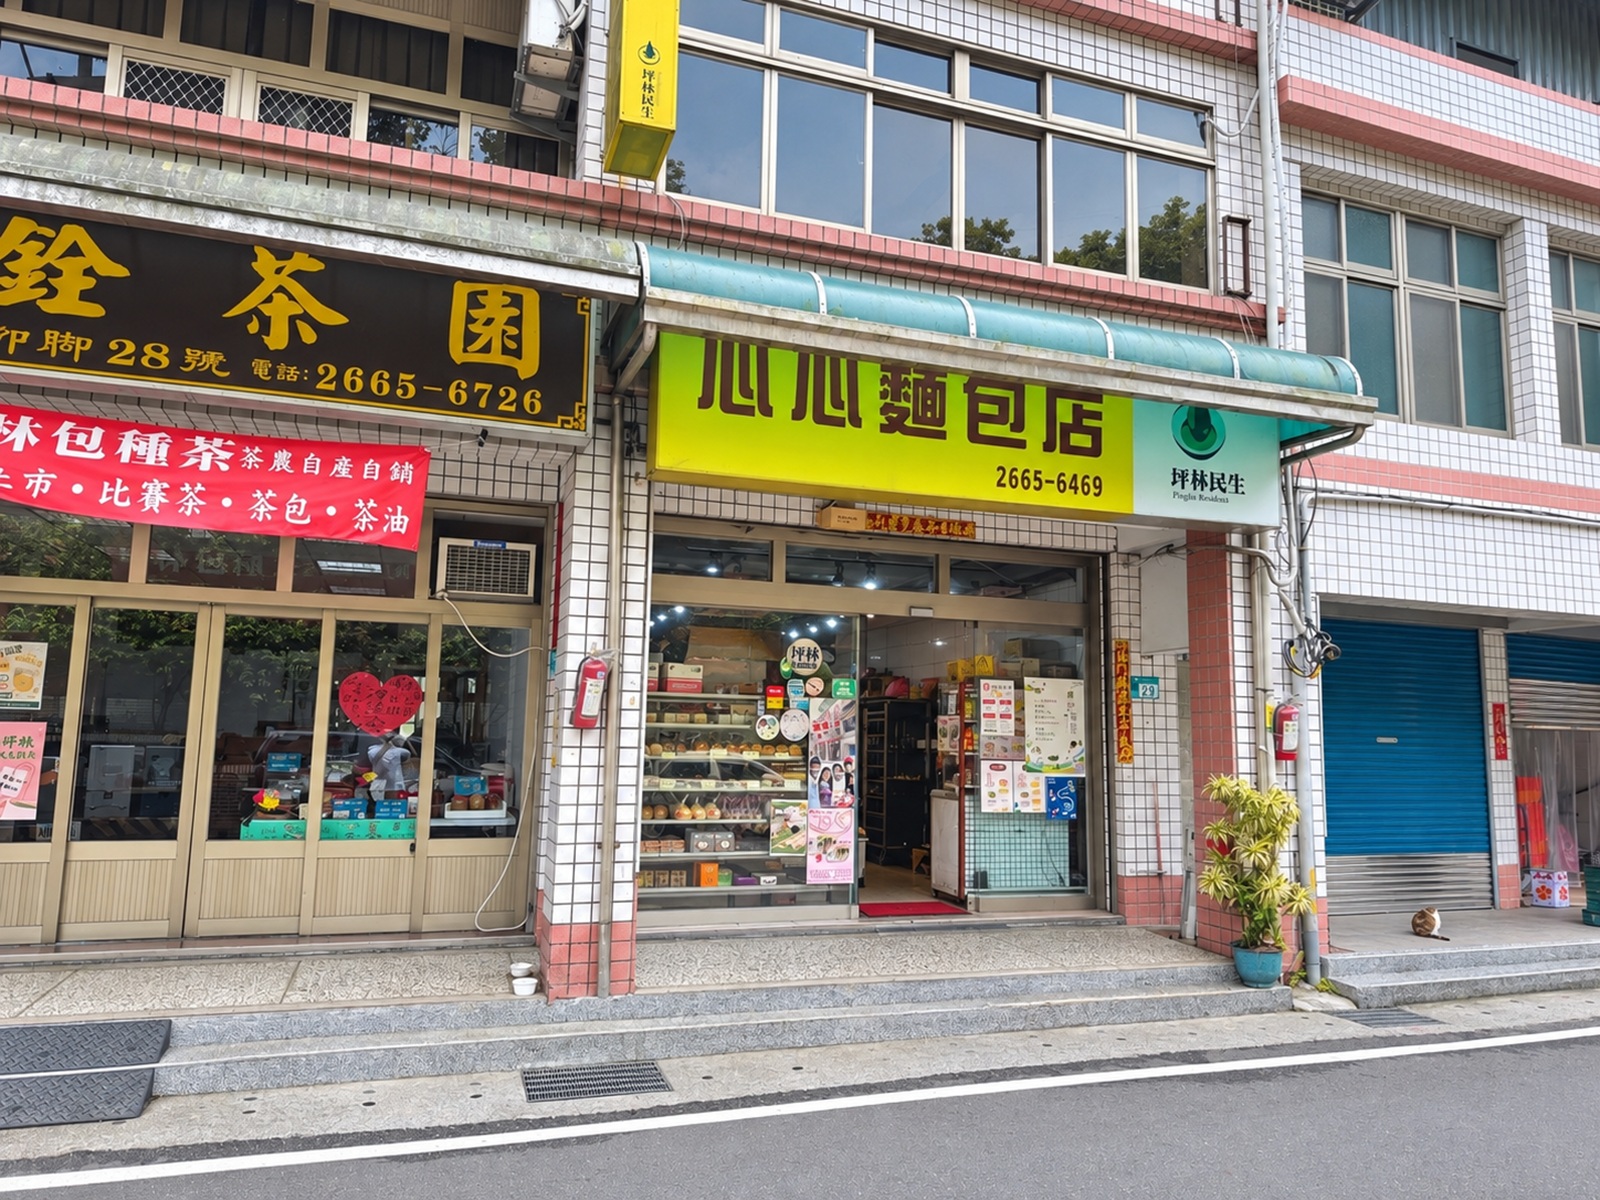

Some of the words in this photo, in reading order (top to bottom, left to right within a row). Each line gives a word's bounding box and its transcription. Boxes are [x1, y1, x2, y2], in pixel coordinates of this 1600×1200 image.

[641, 68, 655, 119] 坪林民生
[314, 363, 543, 416] 2665-6726
[697, 336, 1104, 459] 心心麵包店
[995, 465, 1103, 498] 2665-6469
[1170, 467, 1246, 496] 坪林民生
[98, 477, 207, 517] 比賽茶
[247, 488, 312, 525] 茶包
[351, 498, 410, 535] 茶油
[791, 645, 820, 662] 坪林
[1141, 685, 1155, 697] 29
